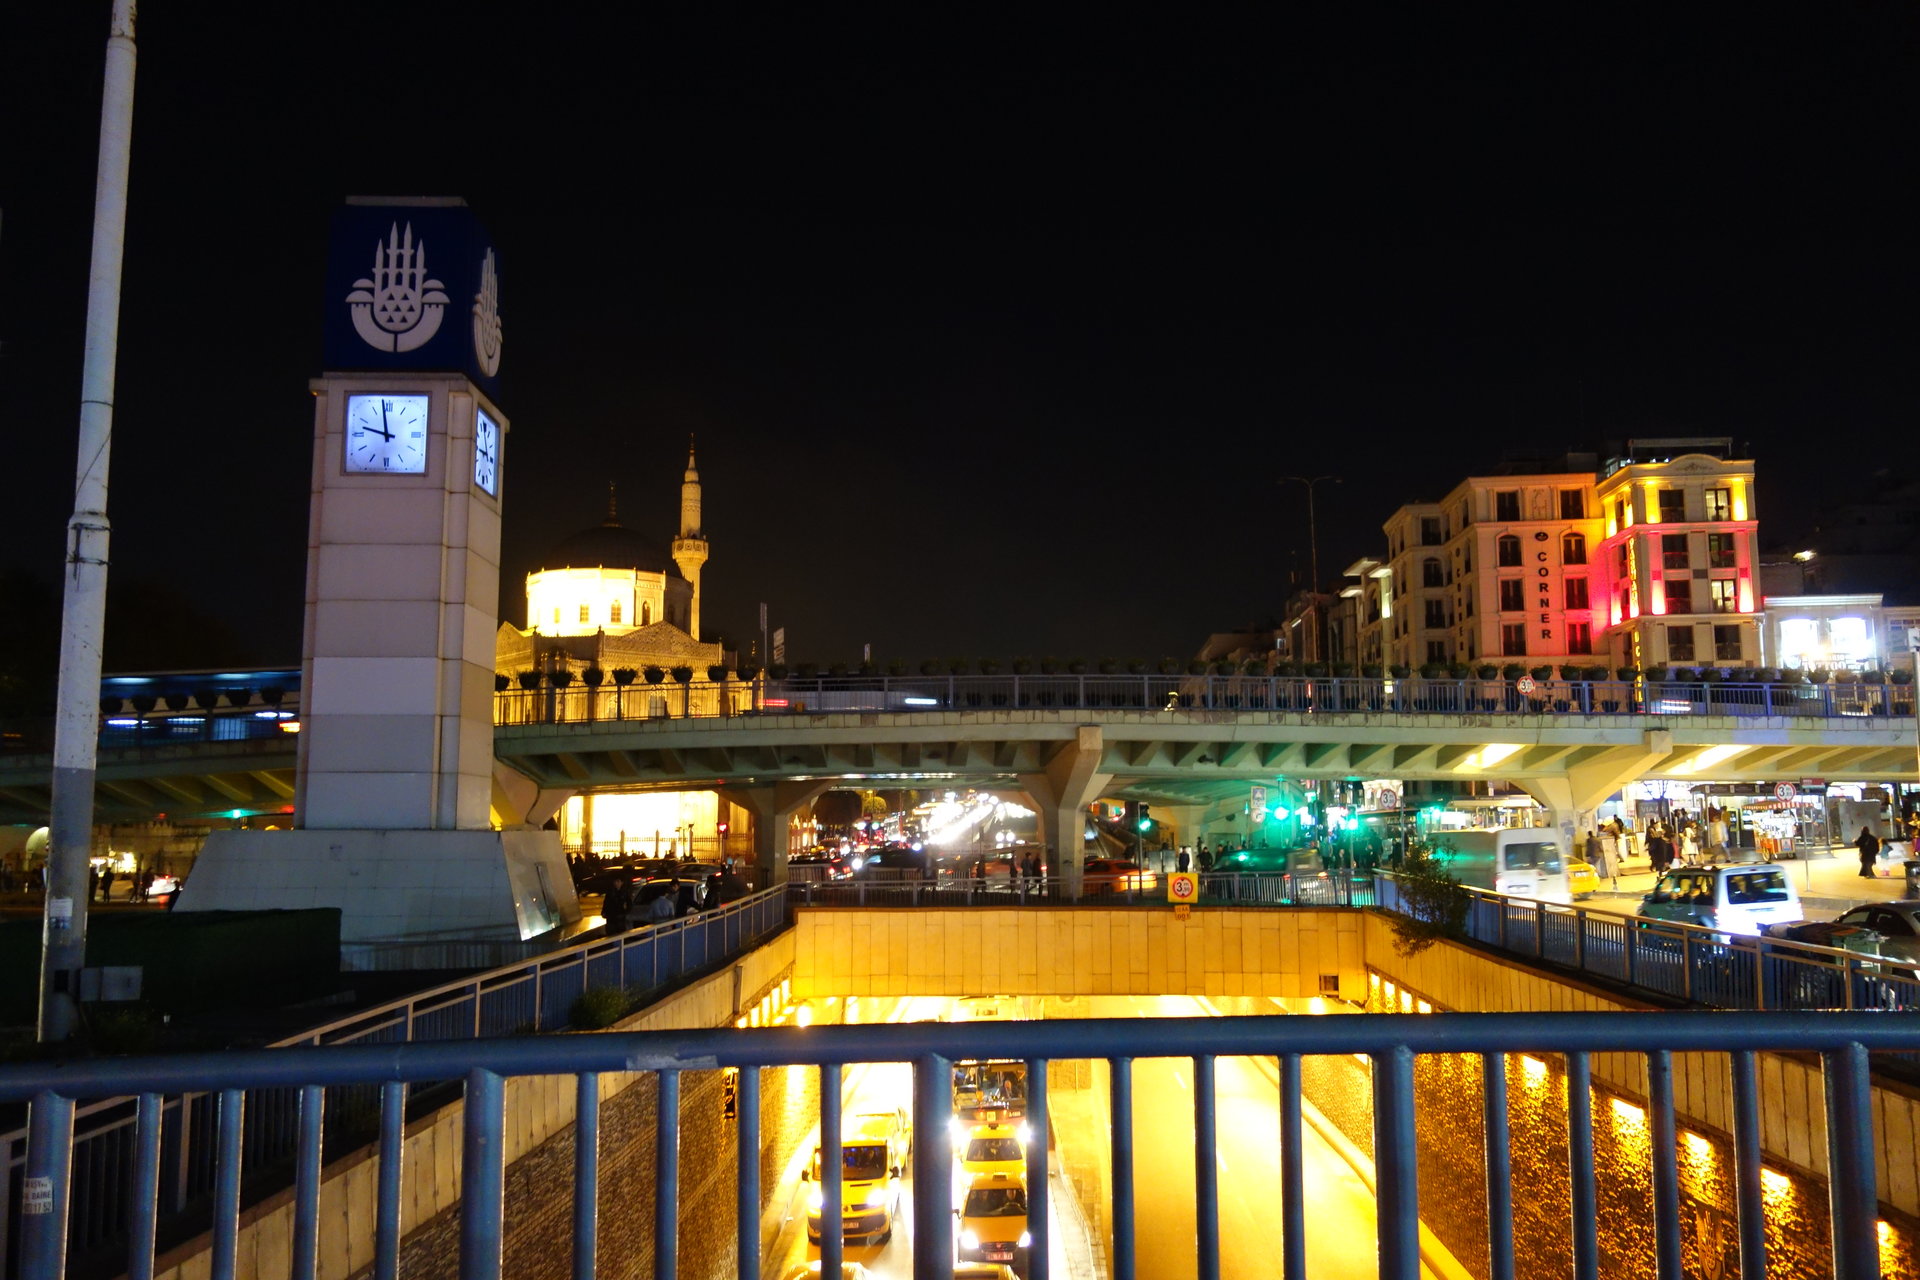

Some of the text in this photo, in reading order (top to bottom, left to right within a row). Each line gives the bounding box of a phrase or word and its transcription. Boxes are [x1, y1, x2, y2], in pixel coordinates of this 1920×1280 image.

[1537, 551, 1552, 640] CORNER
[1778, 786, 1785, 797] 3
[1383, 793, 1389, 804] 3
[1176, 881, 1183, 892] 3
